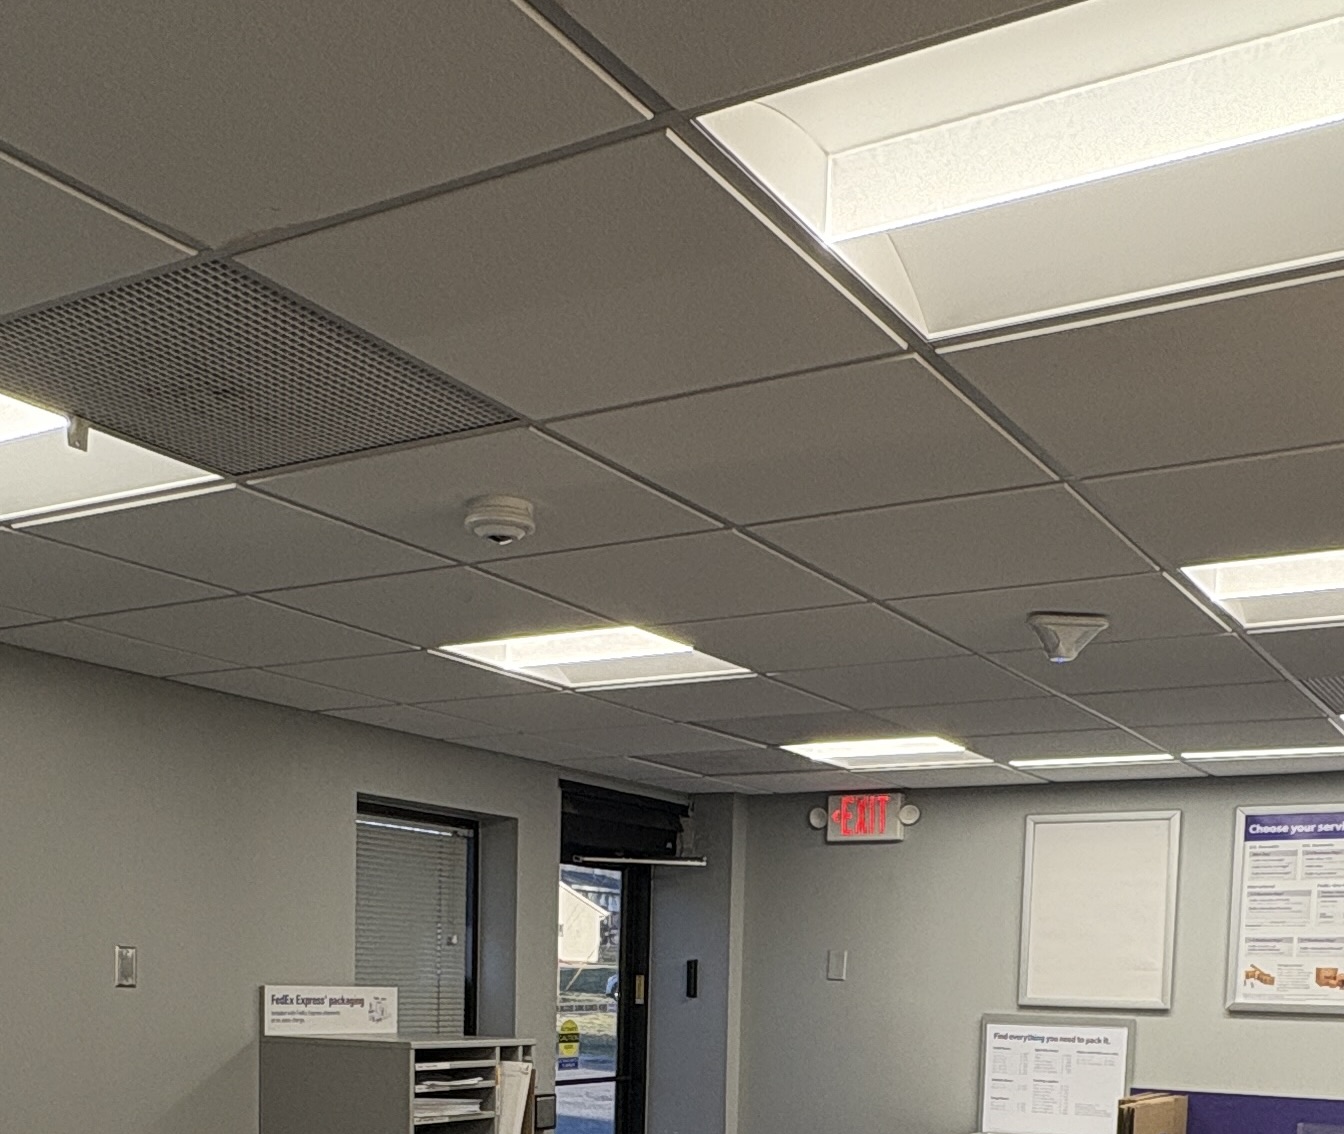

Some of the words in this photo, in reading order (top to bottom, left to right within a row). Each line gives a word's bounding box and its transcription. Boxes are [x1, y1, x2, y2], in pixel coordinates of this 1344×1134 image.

[840, 794, 890, 836] EXIT
[1249, 824, 1289, 834] Choose
[1291, 824, 1316, 835] your
[271, 995, 294, 1005] FedEx
[329, 996, 364, 1008] packaging
[1009, 1034, 1044, 1043] everything
